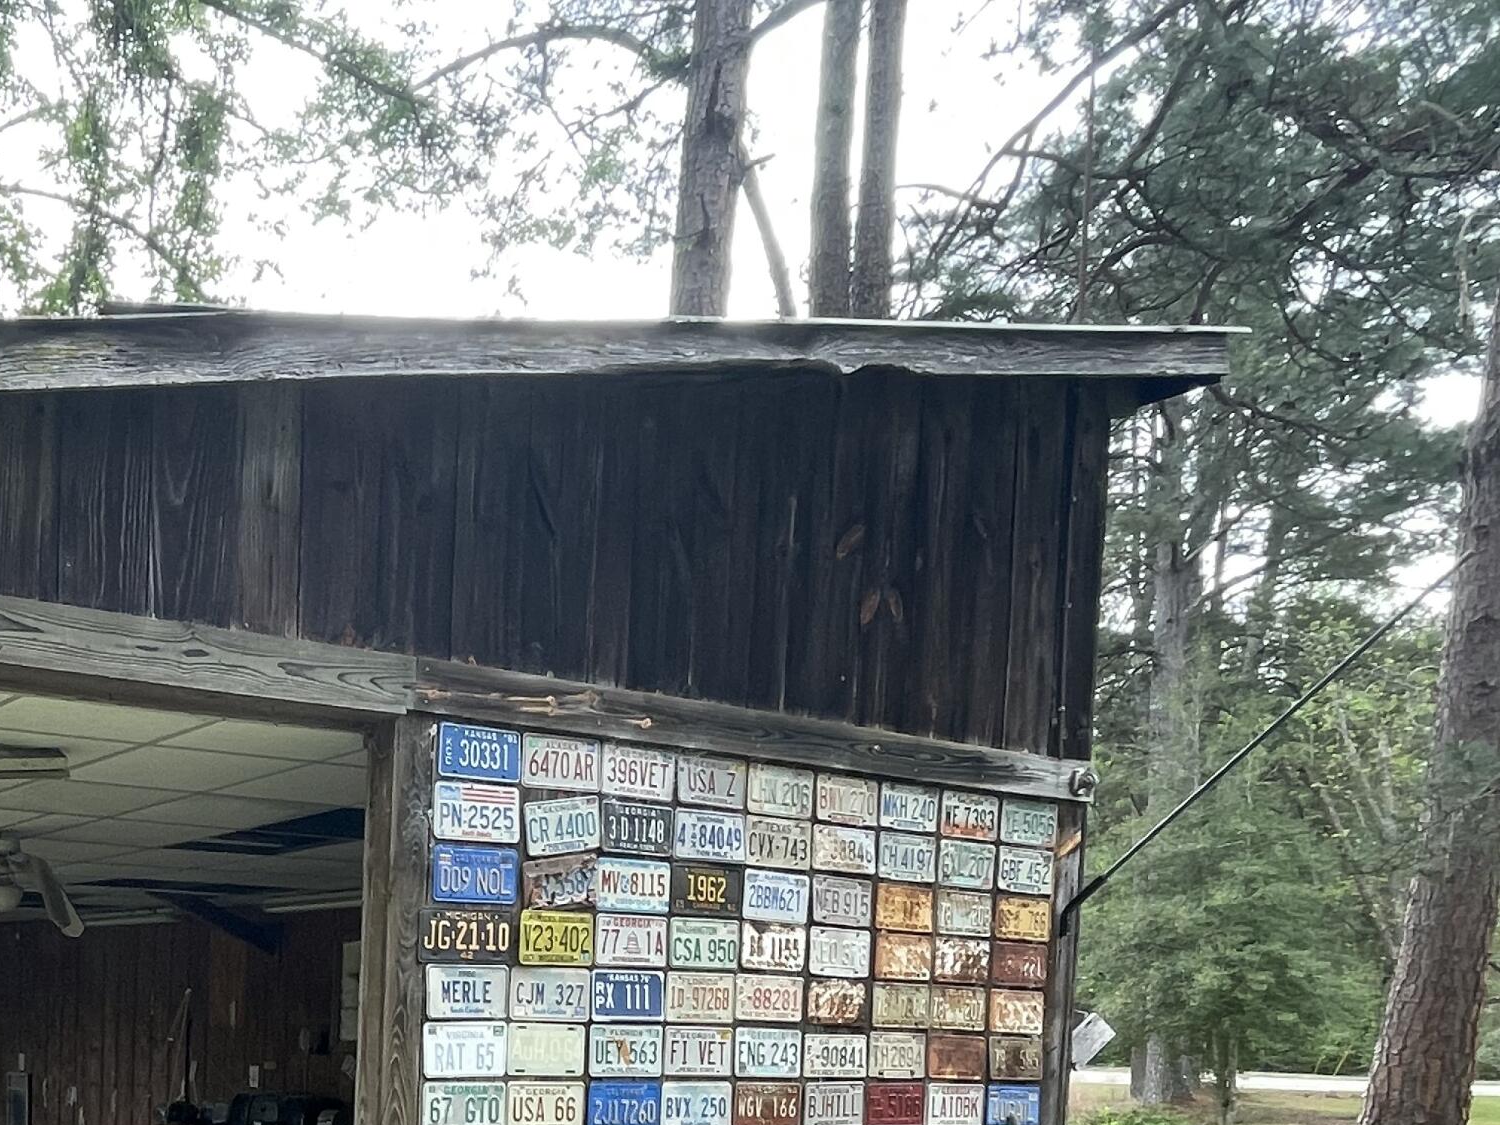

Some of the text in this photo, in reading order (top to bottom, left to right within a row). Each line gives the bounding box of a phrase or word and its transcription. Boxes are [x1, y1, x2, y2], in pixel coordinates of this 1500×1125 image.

[459, 739, 509, 771] 30331
[529, 750, 594, 782] 6470 AR
[607, 757, 670, 789] 396VET
[687, 766, 736, 797] USA Z
[912, 798, 936, 822] 240
[964, 807, 995, 832] 7393
[529, 811, 596, 846] CR 4400
[699, 825, 742, 851] 84049
[766, 823, 793, 834] TEXAS
[901, 846, 933, 872] 4197
[969, 856, 992, 880] 207
[1001, 858, 1051, 885] GBF 452
[440, 865, 512, 896] 009 NOL
[601, 869, 666, 898] MV 8115
[686, 874, 727, 904] 1962
[444, 912, 492, 921] MICHIGAN
[843, 891, 869, 917] 915
[613, 917, 652, 928] GEORGIA
[601, 928, 621, 955] 77
[674, 937, 737, 963] CSA 950
[441, 980, 492, 1004] MERLE
[516, 982, 585, 1007] CJM 327
[626, 983, 651, 1010] 111
[446, 1030, 484, 1039] VIRGINIA
[434, 1042, 495, 1073] RAT 65
[629, 1040, 658, 1066] 563
[671, 1040, 727, 1067] FI VET
[738, 1041, 765, 1067] ENG
[770, 1042, 798, 1067] 243
[443, 1085, 489, 1096] GEORGIA
[525, 1088, 567, 1096] GEORGIA
[430, 1096, 500, 1125] 67 GTO
[512, 1096, 576, 1122] USA 66
[665, 1097, 727, 1119] BVX 250
[772, 1096, 797, 1118] 166
[808, 1094, 860, 1118] BJHILL
